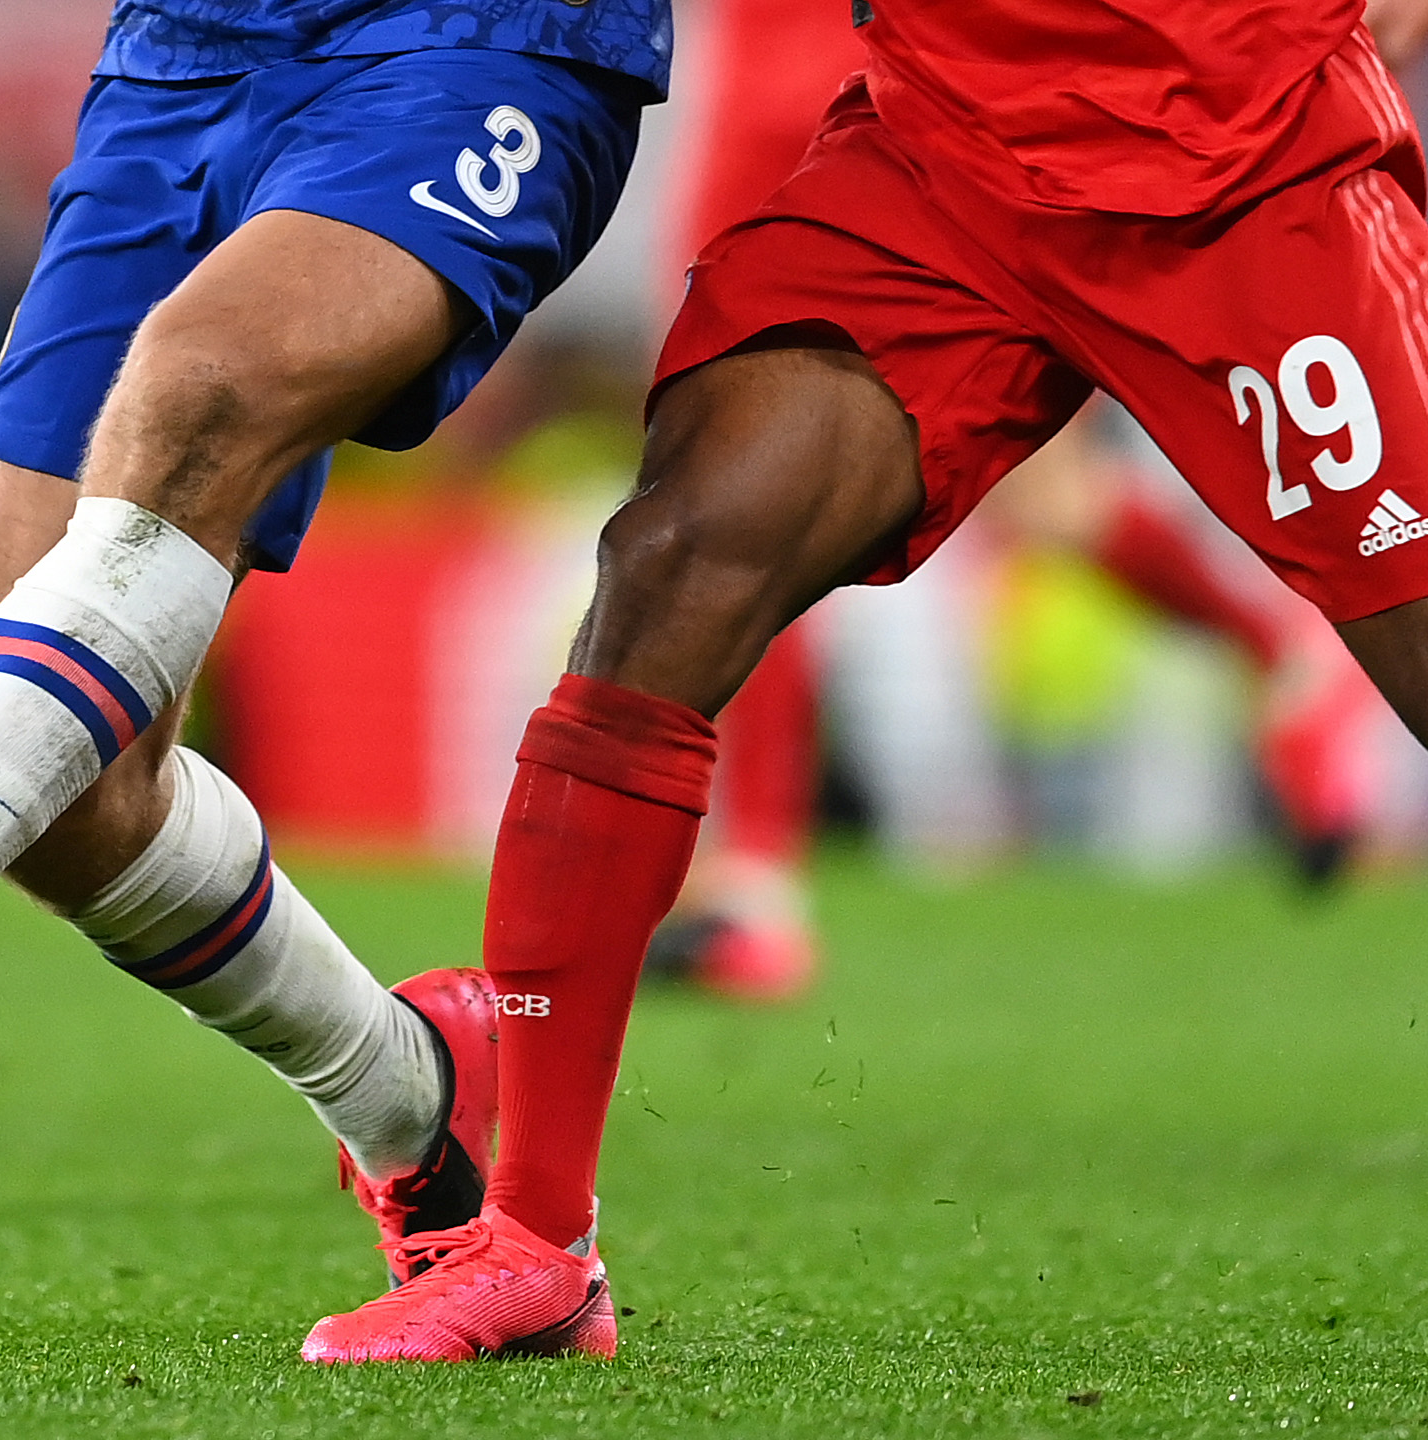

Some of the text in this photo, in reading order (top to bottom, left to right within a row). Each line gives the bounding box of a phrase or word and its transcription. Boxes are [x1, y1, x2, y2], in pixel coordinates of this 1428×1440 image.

[455, 105, 541, 218] 3
[1228, 334, 1383, 521] 29
[494, 993, 552, 1023] FCB
